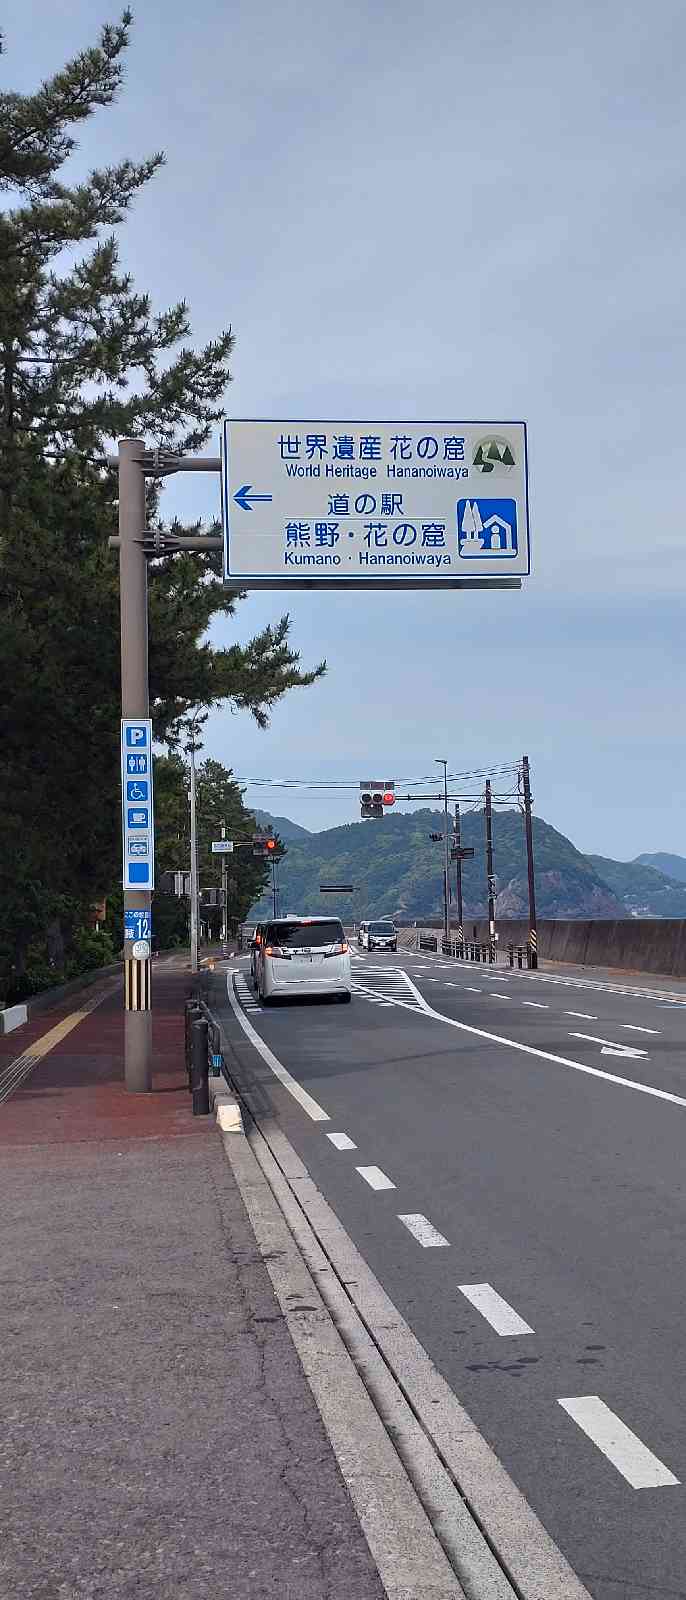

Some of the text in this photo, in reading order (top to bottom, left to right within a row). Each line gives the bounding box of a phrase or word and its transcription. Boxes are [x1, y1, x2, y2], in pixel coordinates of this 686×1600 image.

[277, 434, 466, 461] 世界遺産 花の窟
[285, 463, 469, 480] World Heritage Hananoiwaya
[327, 492, 404, 516] 道の駅
[284, 521, 446, 548] 熊野・花の窟
[284, 552, 342, 566] Kumano
[358, 552, 452, 567] Hananoiwaya
[131, 728, 144, 745] P
